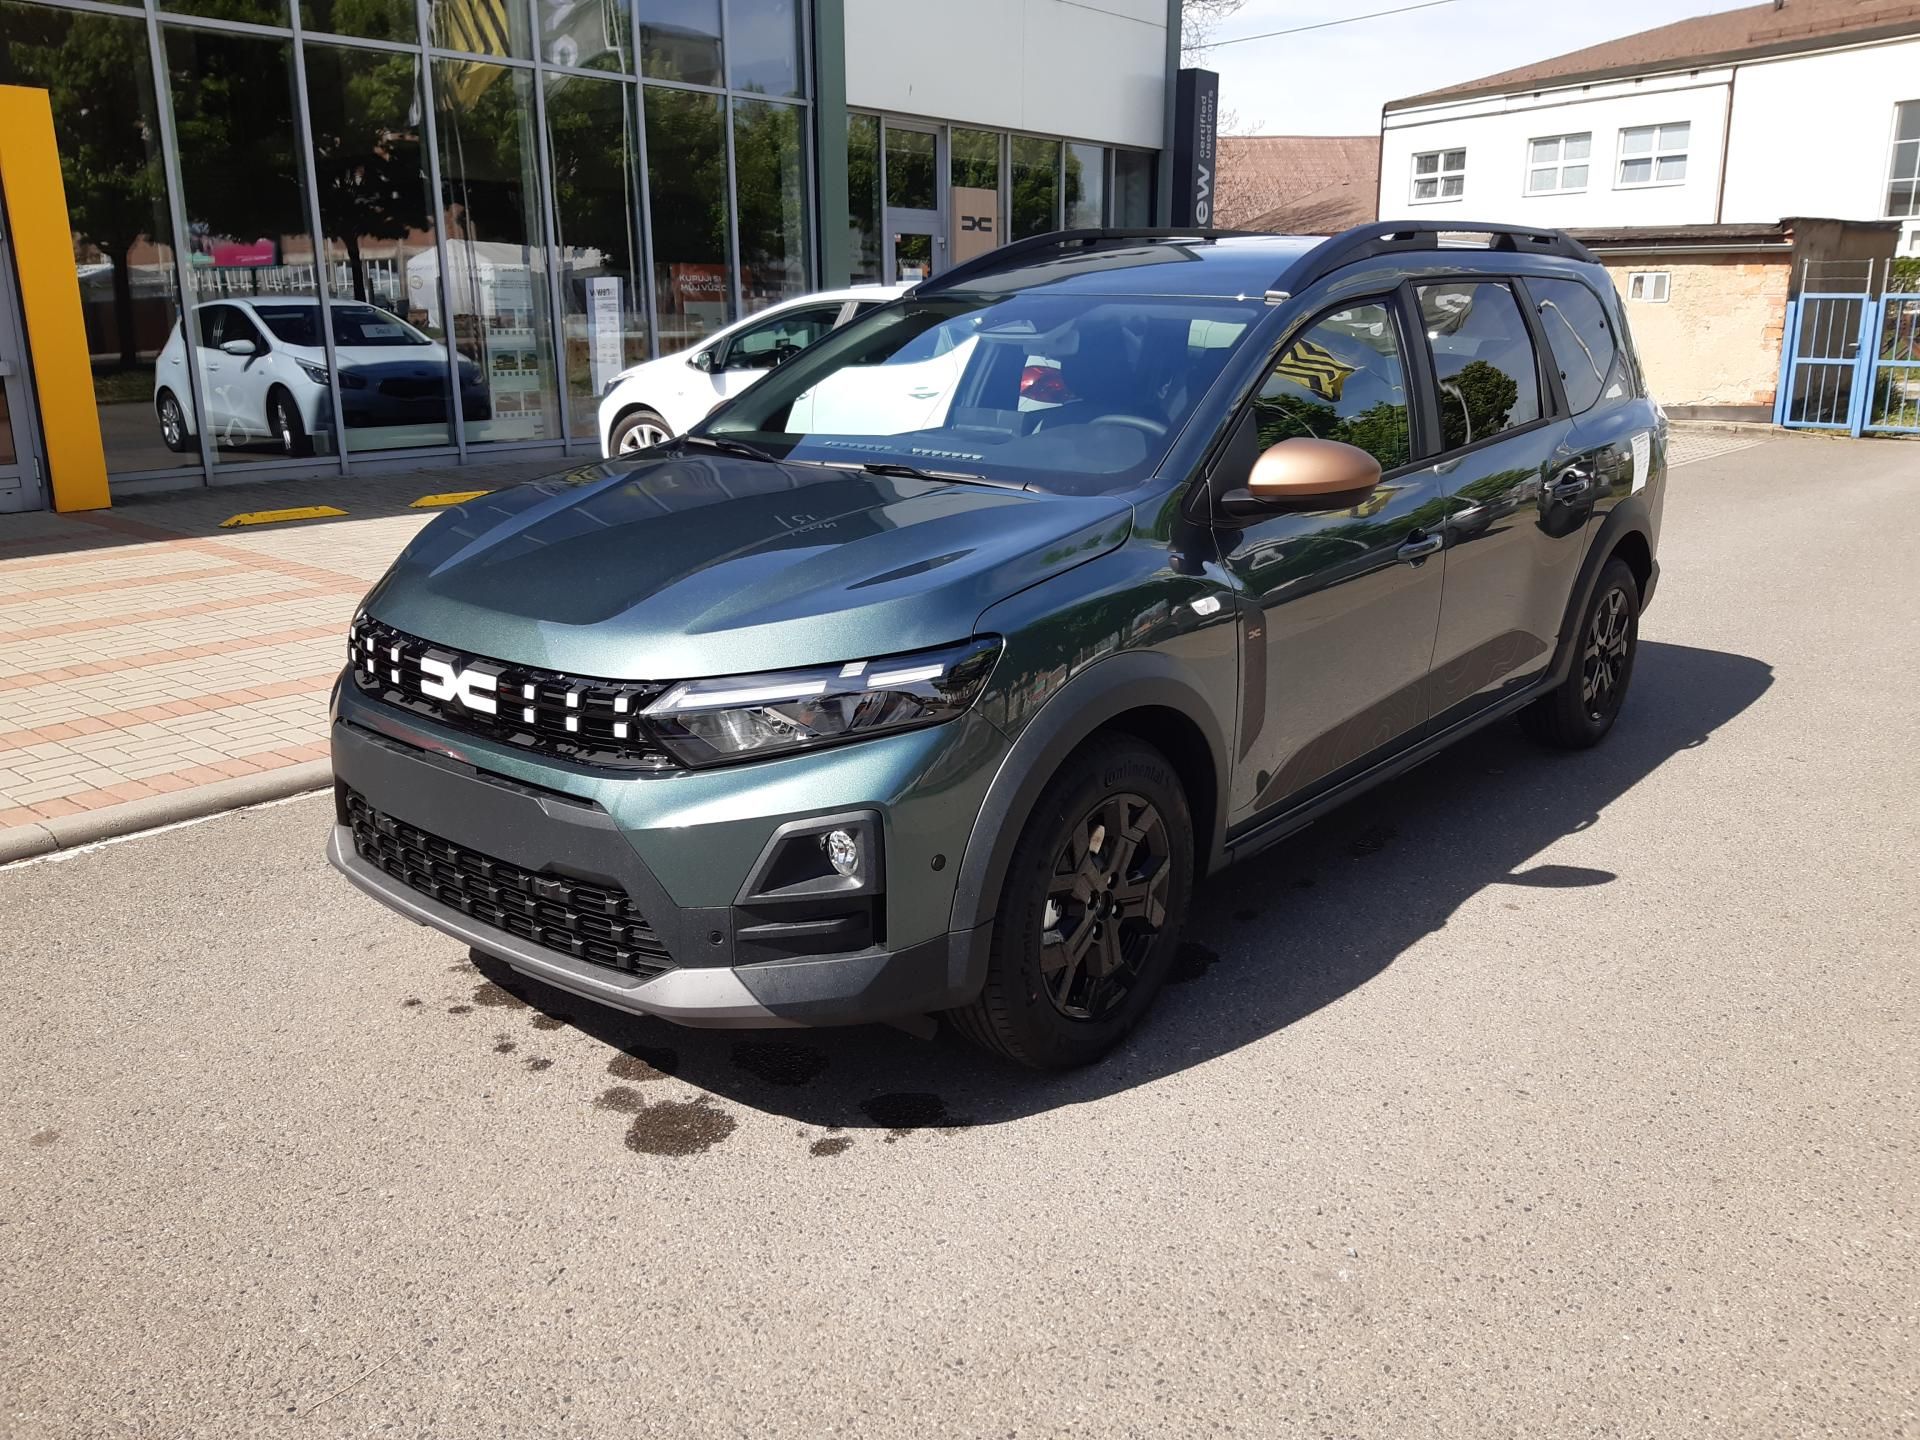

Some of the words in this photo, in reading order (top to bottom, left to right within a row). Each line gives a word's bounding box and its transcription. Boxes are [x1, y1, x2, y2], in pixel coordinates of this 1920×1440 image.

[1199, 95, 1207, 158] certified
[1196, 164, 1210, 229] ew
[1103, 759, 1165, 788] Continental
